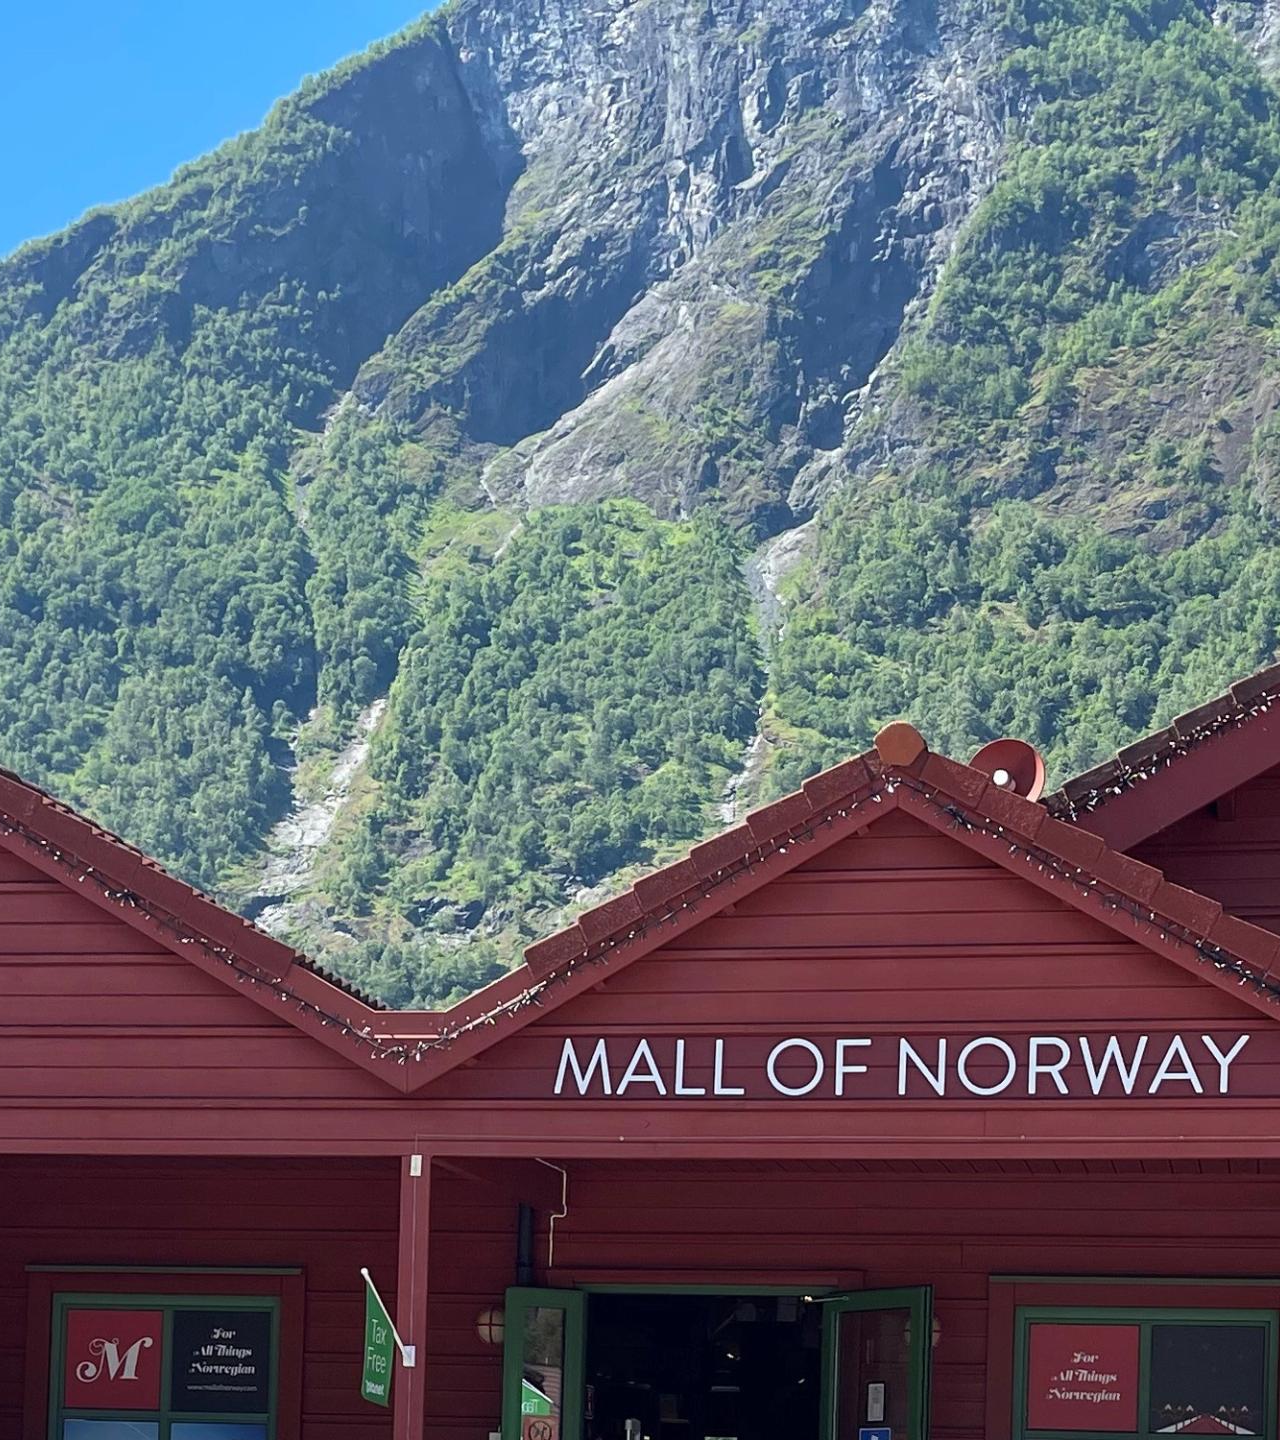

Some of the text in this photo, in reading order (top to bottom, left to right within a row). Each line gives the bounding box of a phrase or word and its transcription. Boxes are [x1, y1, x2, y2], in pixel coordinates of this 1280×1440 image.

[553, 1034, 1250, 1096] MALL OF NORWAY
[211, 1327, 236, 1339] For
[371, 1319, 387, 1345] Tax
[76, 1336, 154, 1383] M
[193, 1344, 252, 1359] All Things
[1071, 1352, 1099, 1363] For
[367, 1346, 386, 1374] Free
[190, 1361, 256, 1377] Norwegian
[1051, 1369, 1117, 1385] All Things
[1047, 1387, 1121, 1403] Norwegian
